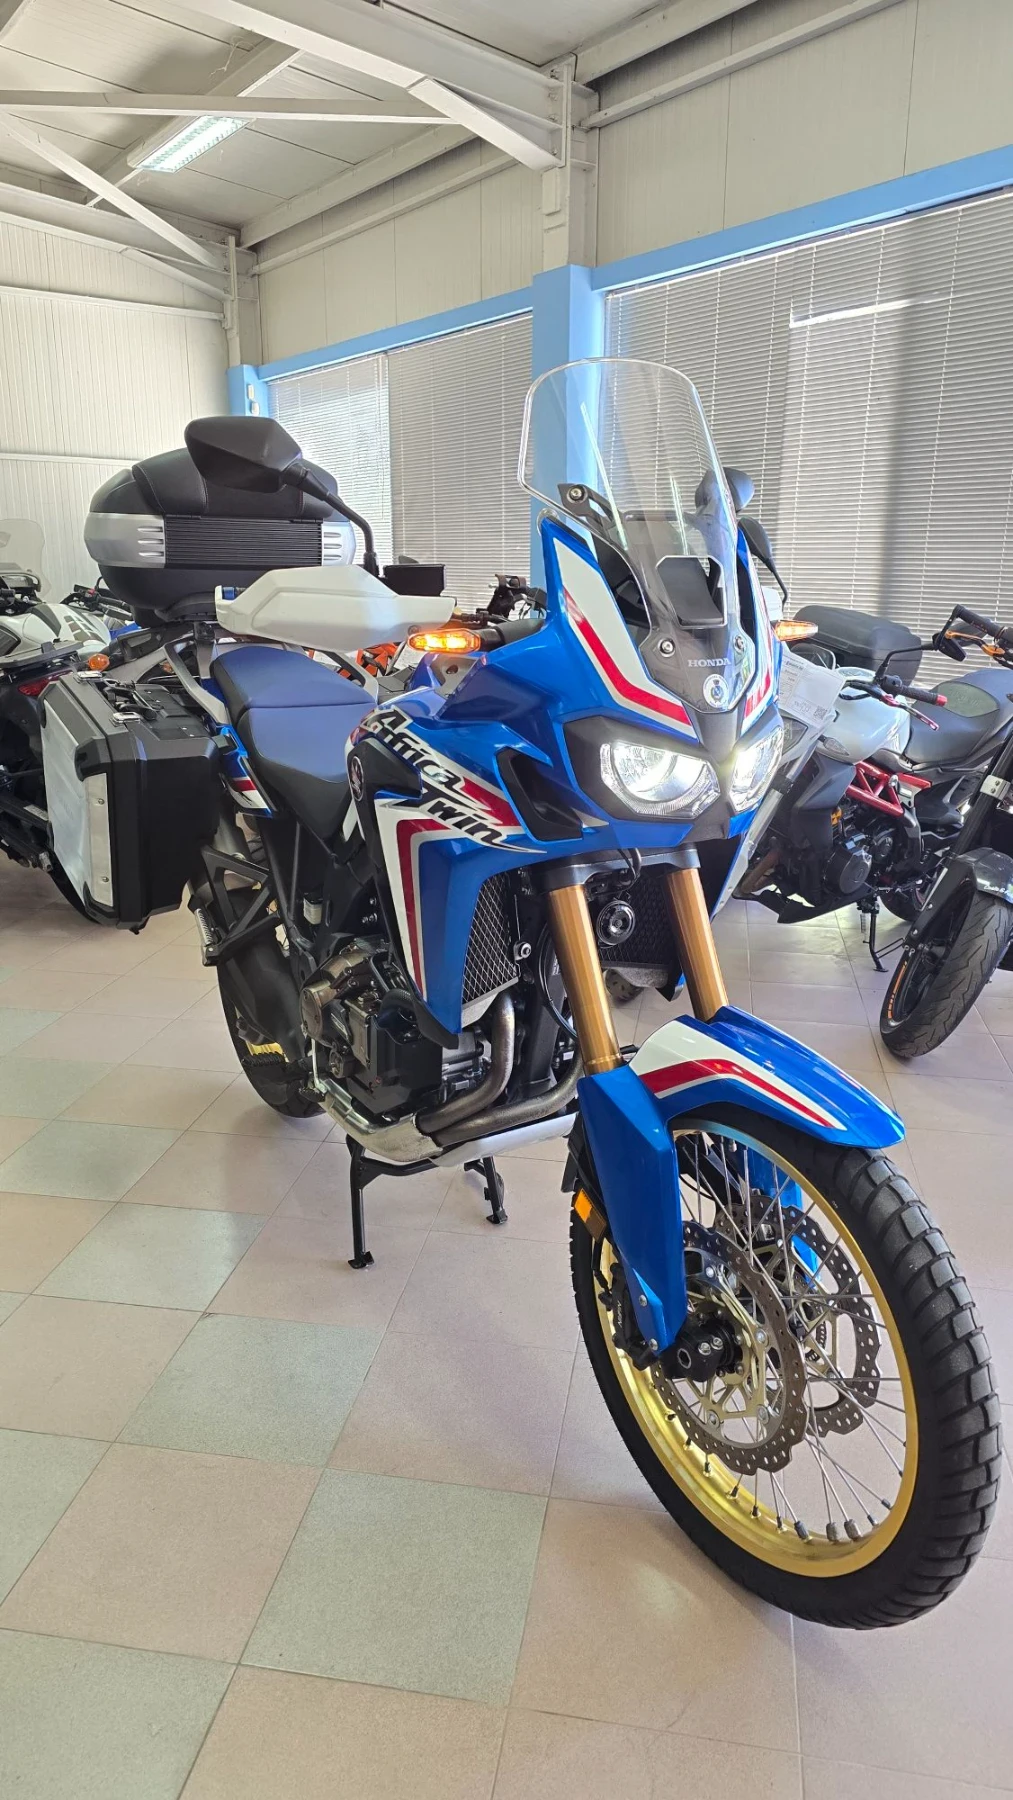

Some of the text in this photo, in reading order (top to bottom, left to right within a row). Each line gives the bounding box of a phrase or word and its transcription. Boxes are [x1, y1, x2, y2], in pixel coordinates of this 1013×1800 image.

[688, 658, 731, 667] HONDA
[364, 708, 474, 800] Africa
[393, 783, 516, 848] Twin
